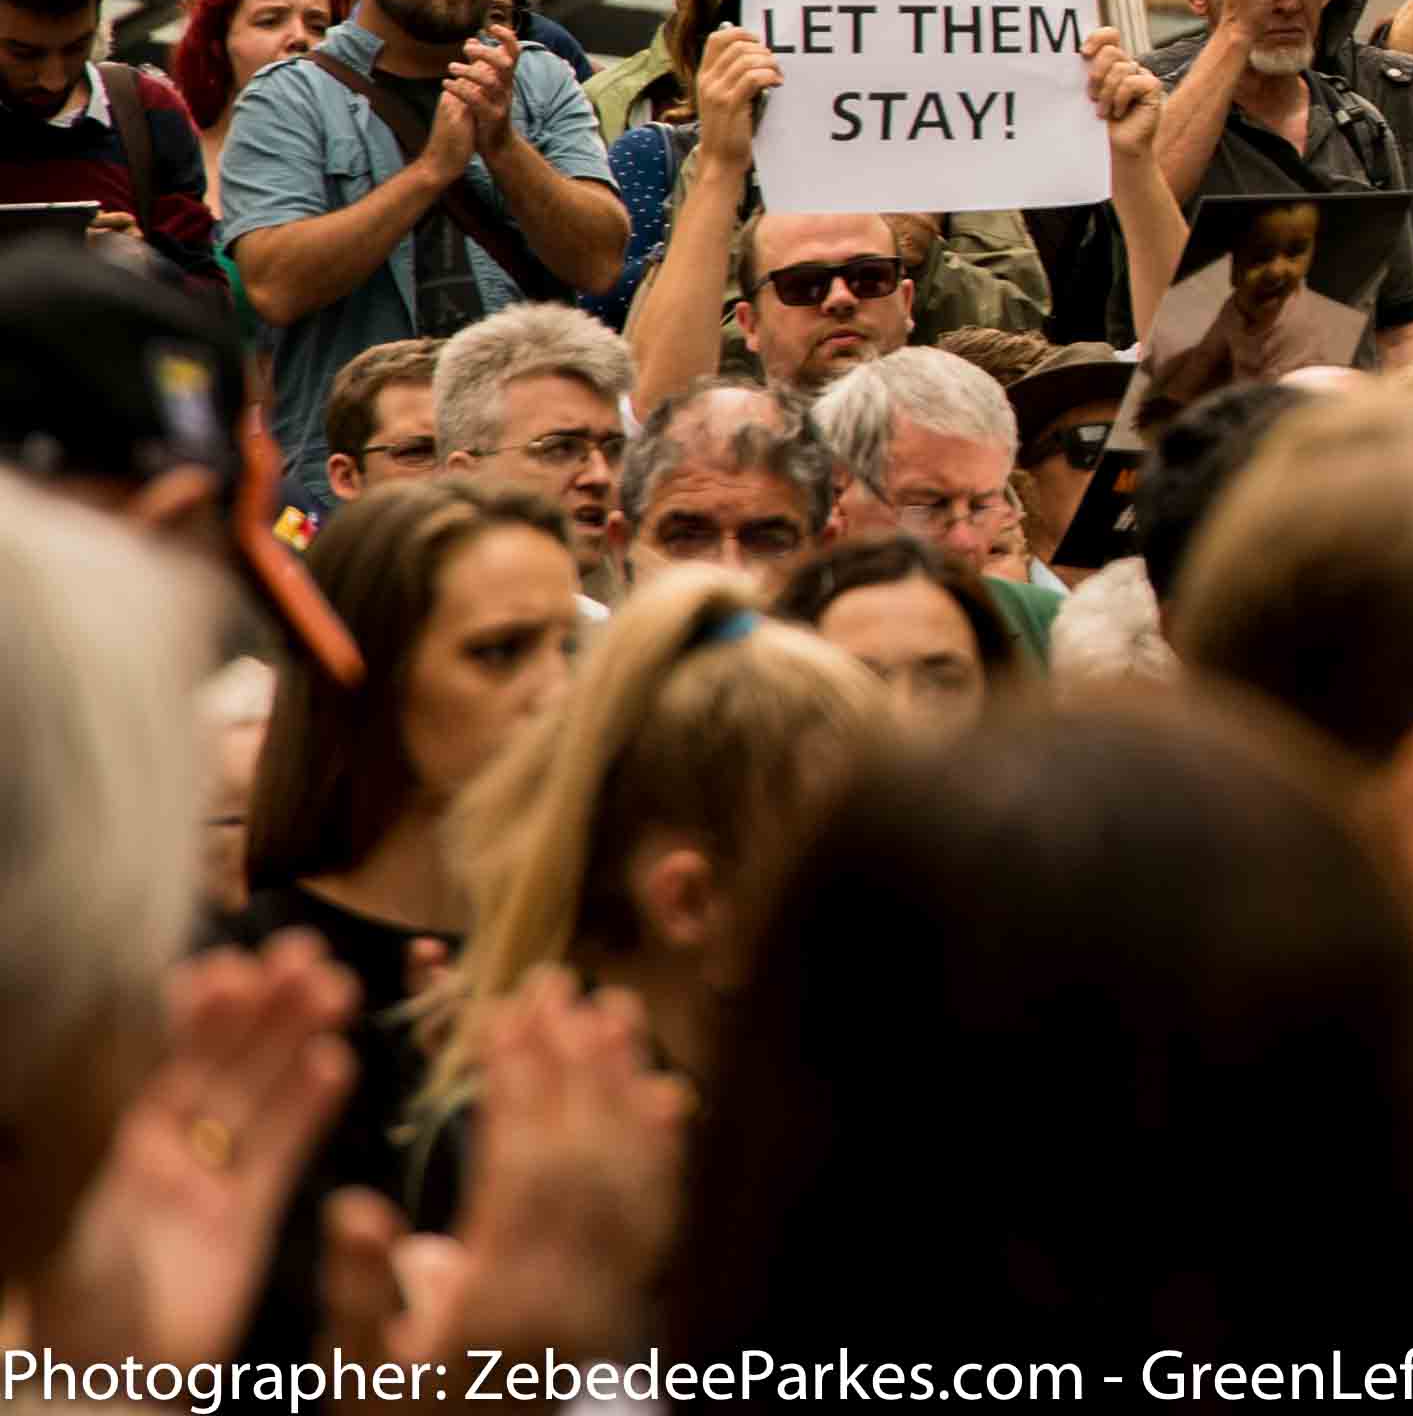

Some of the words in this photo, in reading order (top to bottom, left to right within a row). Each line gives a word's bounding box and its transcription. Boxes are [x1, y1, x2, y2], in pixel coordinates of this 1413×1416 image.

[763, 5, 877, 54] LET
[898, 5, 1083, 54] THEM
[831, 90, 1018, 142] STAY!
